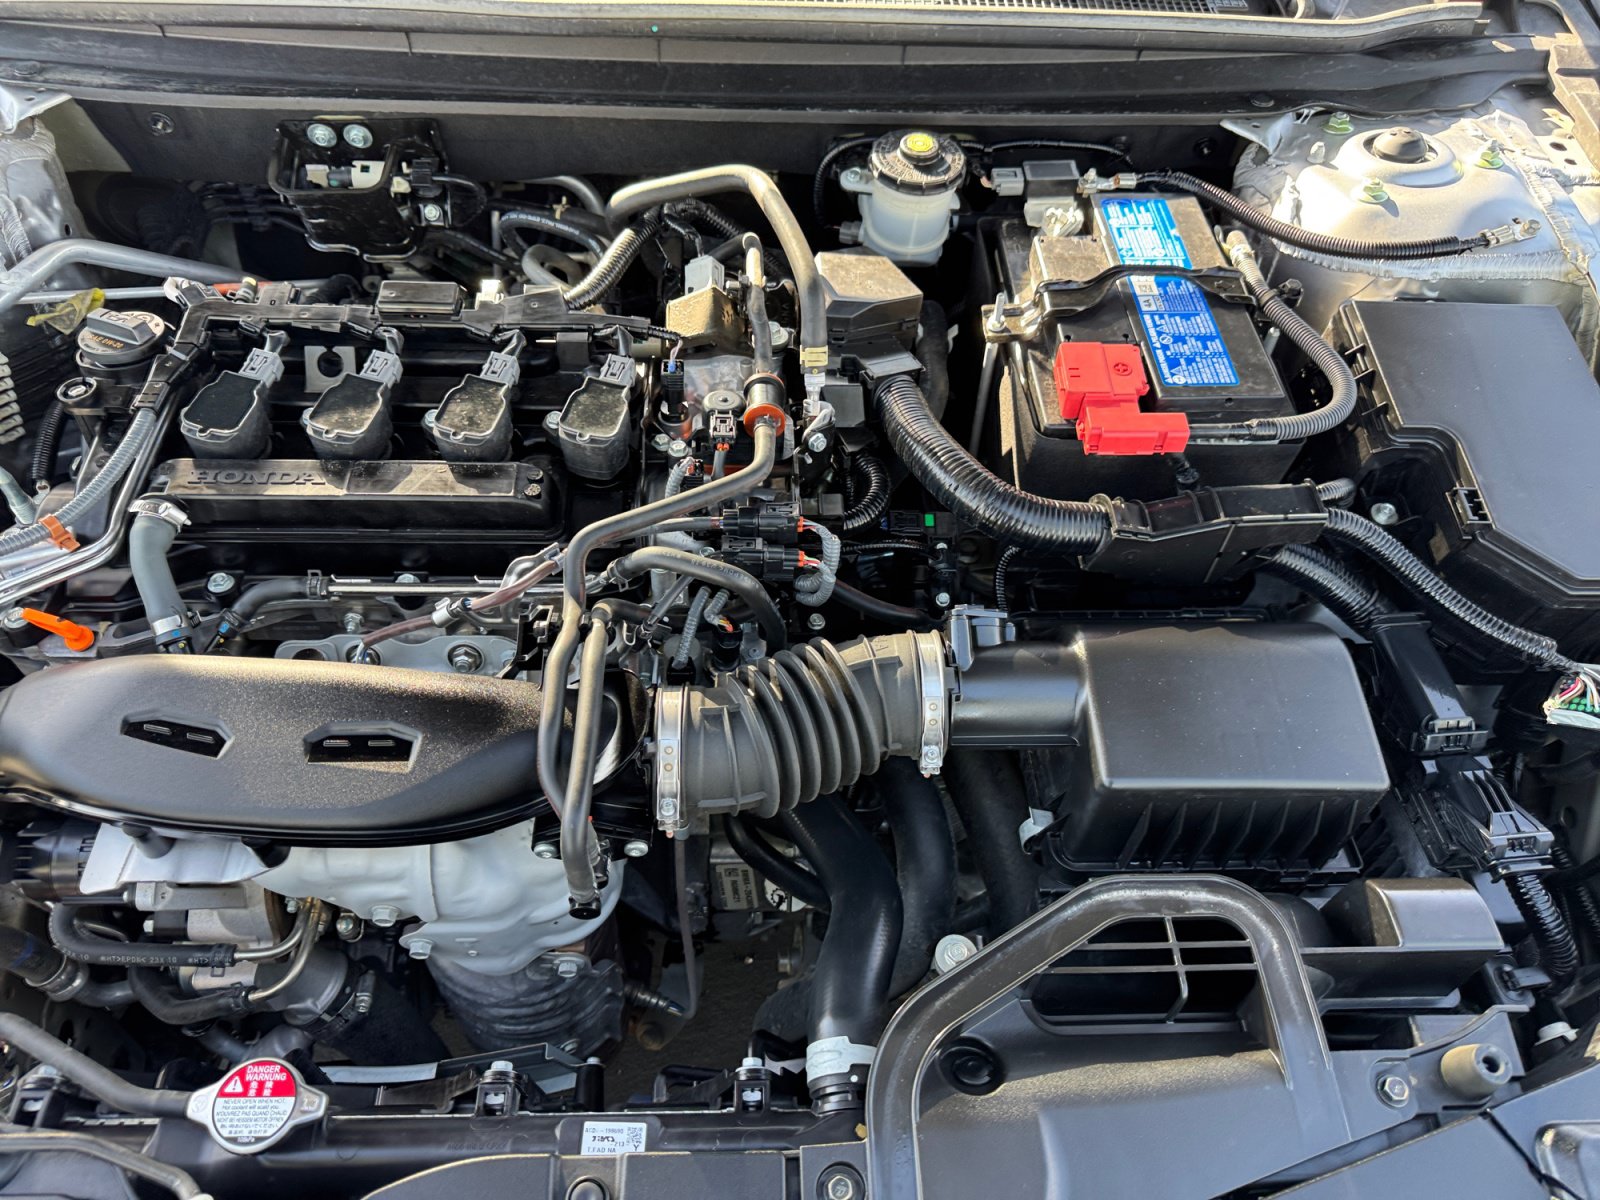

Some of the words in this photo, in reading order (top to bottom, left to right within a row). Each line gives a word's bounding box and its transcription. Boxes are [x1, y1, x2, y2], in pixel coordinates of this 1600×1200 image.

[187, 469, 326, 486] HONDA
[246, 1065, 281, 1073] DANGER
[245, 1072, 287, 1081] WARNUNG
